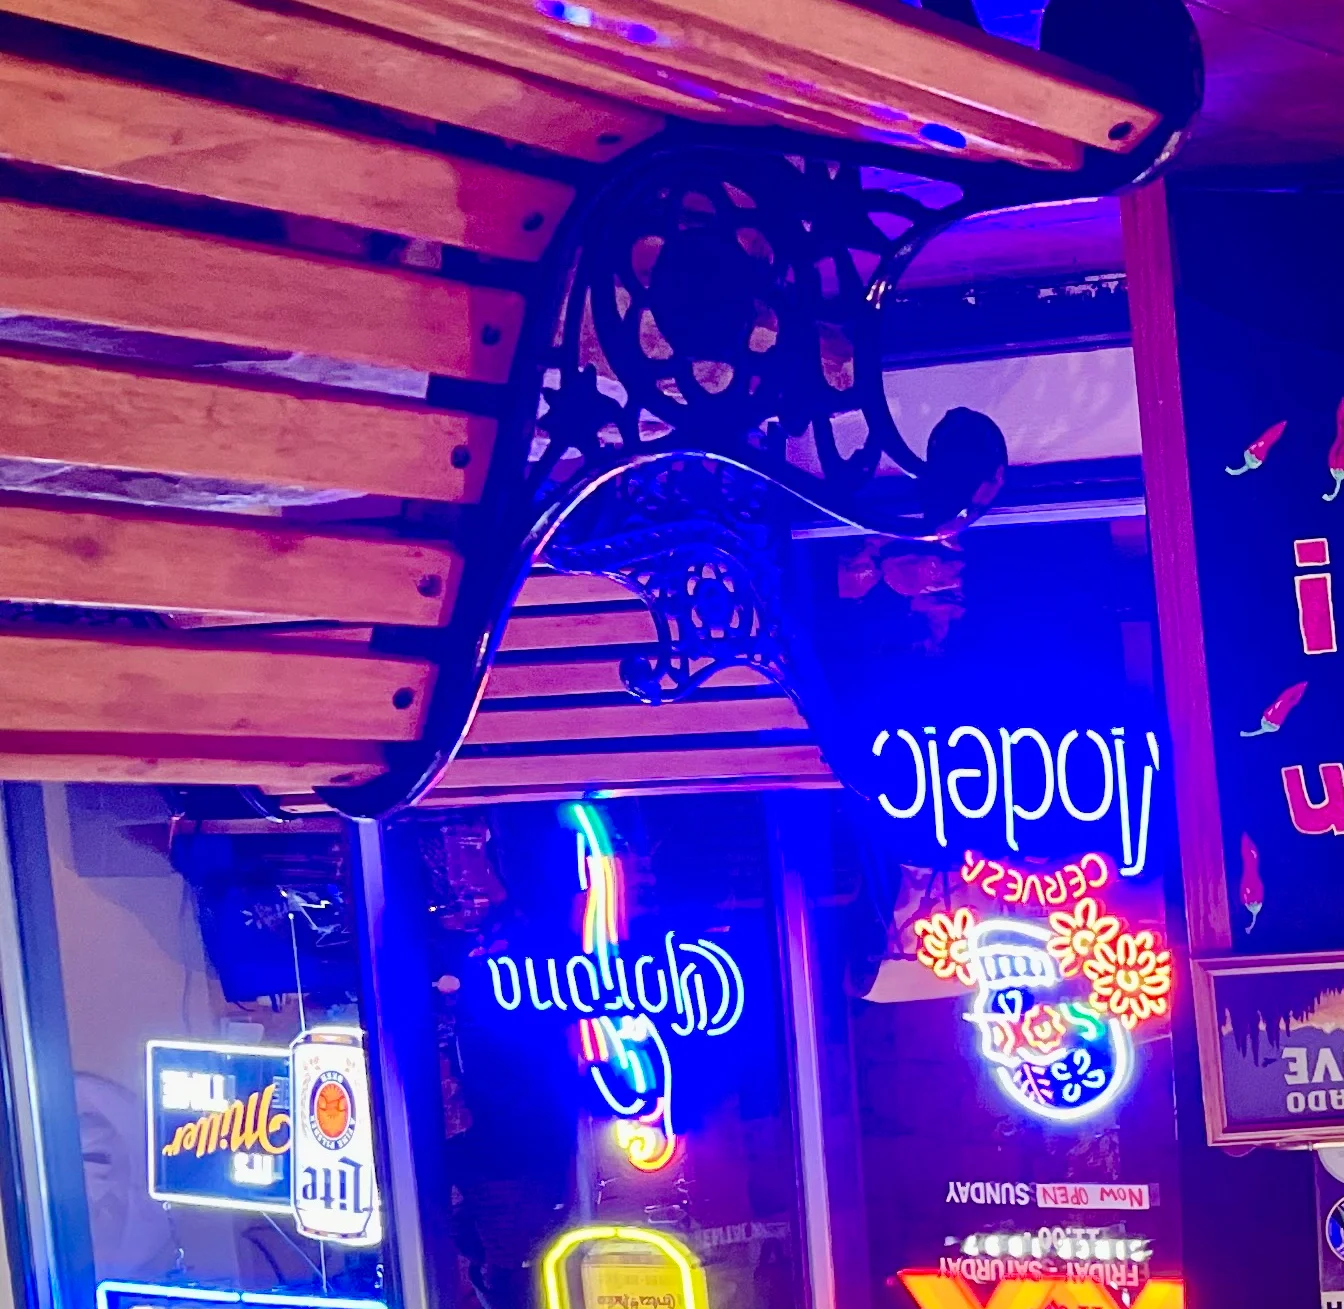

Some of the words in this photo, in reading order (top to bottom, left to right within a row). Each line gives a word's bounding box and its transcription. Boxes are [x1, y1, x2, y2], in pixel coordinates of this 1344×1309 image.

[960, 849, 1108, 906] CERVEZA
[486, 930, 745, 1036] Corona
[161, 1070, 229, 1112] TIME
[319, 1071, 344, 1084] BEER
[162, 1083, 291, 1159] Miller
[301, 1156, 373, 1215] Lite
[945, 1181, 1031, 1206] SUNDAY
[1041, 1185, 1089, 1207] OPEN
[938, 1256, 1042, 1283] SATURDAY
[1062, 1262, 1139, 1287] FRIDAY
